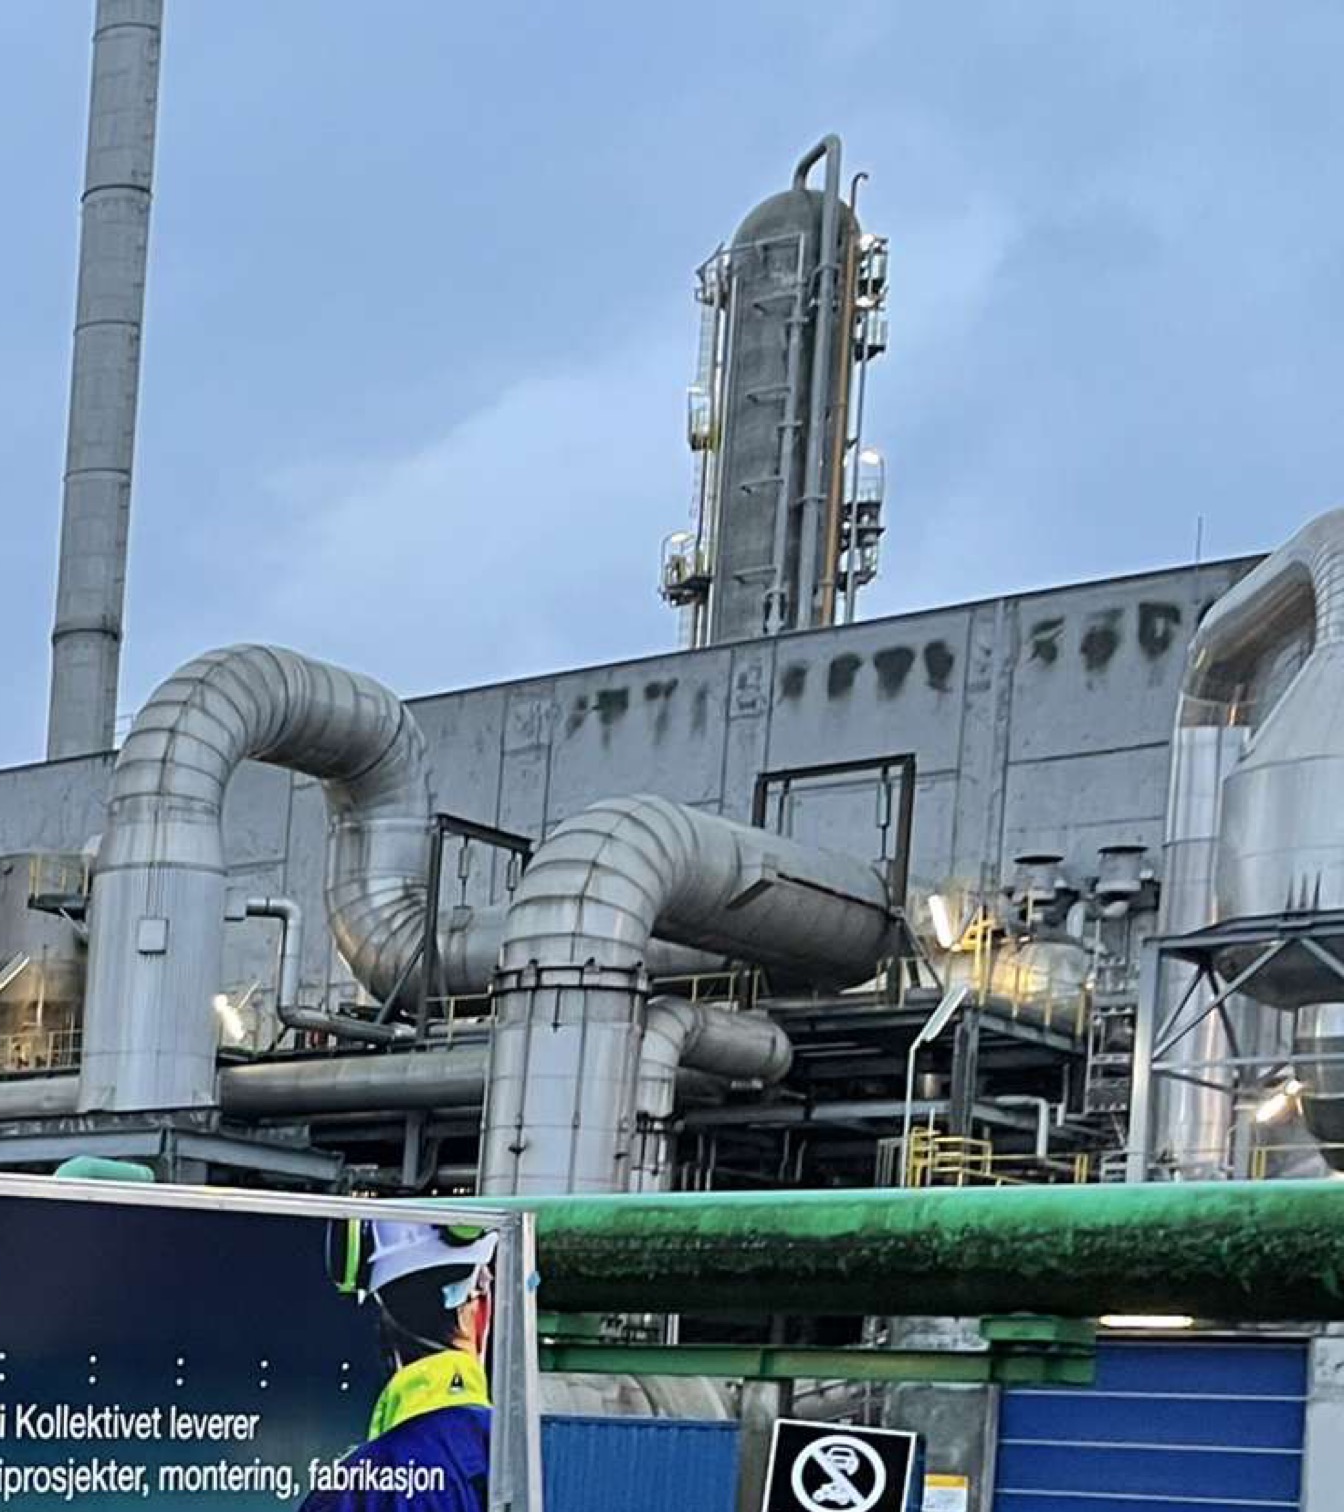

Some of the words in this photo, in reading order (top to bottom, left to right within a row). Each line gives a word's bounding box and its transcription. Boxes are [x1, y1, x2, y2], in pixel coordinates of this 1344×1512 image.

[15, 1405, 162, 1442] Kollektivet
[169, 1407, 260, 1440] leverer
[158, 1457, 300, 1498] montering,
[308, 1459, 445, 1500] fabrikasjon
